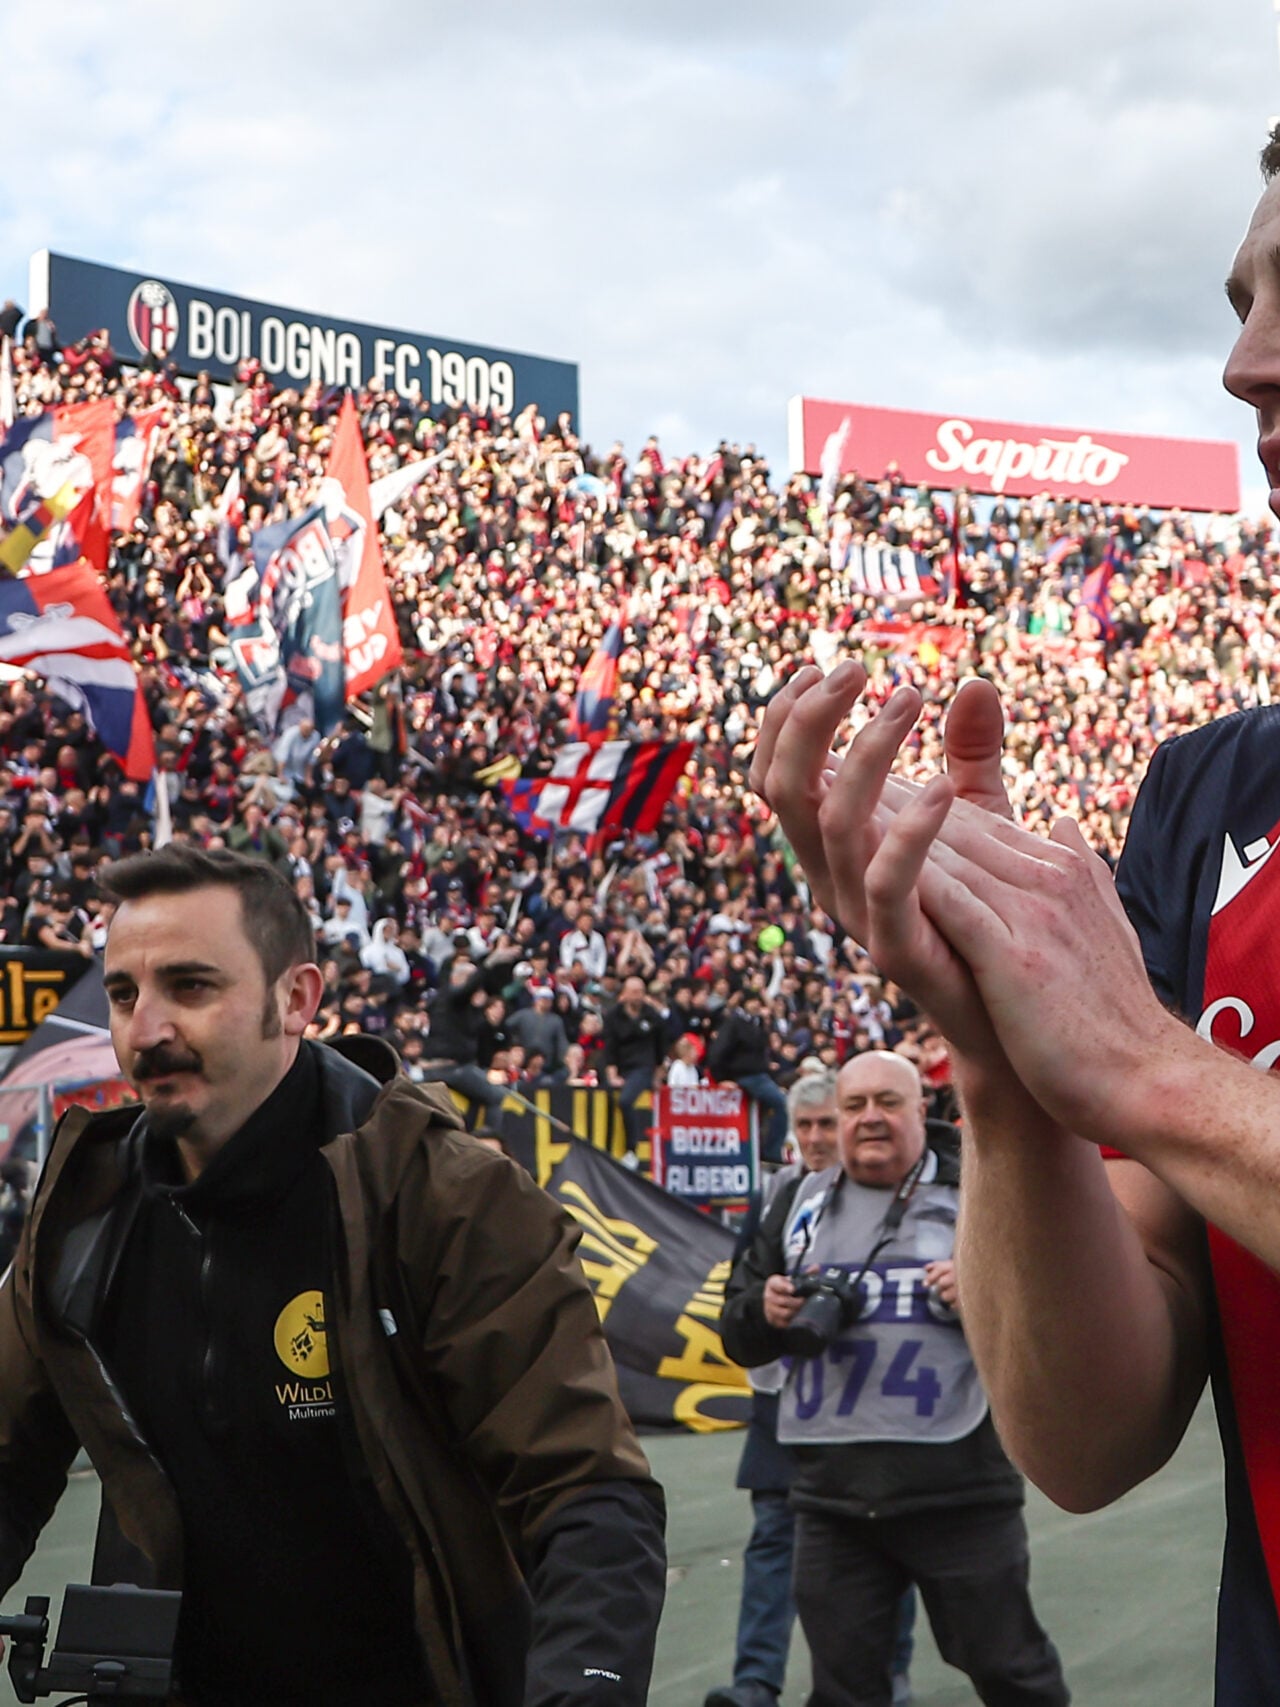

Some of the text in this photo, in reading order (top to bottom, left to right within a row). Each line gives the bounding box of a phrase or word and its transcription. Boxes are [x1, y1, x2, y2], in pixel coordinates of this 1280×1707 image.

[188, 300, 514, 415] BOLOGNA FC 1909
[926, 419, 1129, 492] Saputo
[671, 1125, 741, 1155] BOZZA
[667, 1165, 750, 1194] ALBERO
[796, 1340, 942, 1421] 074
